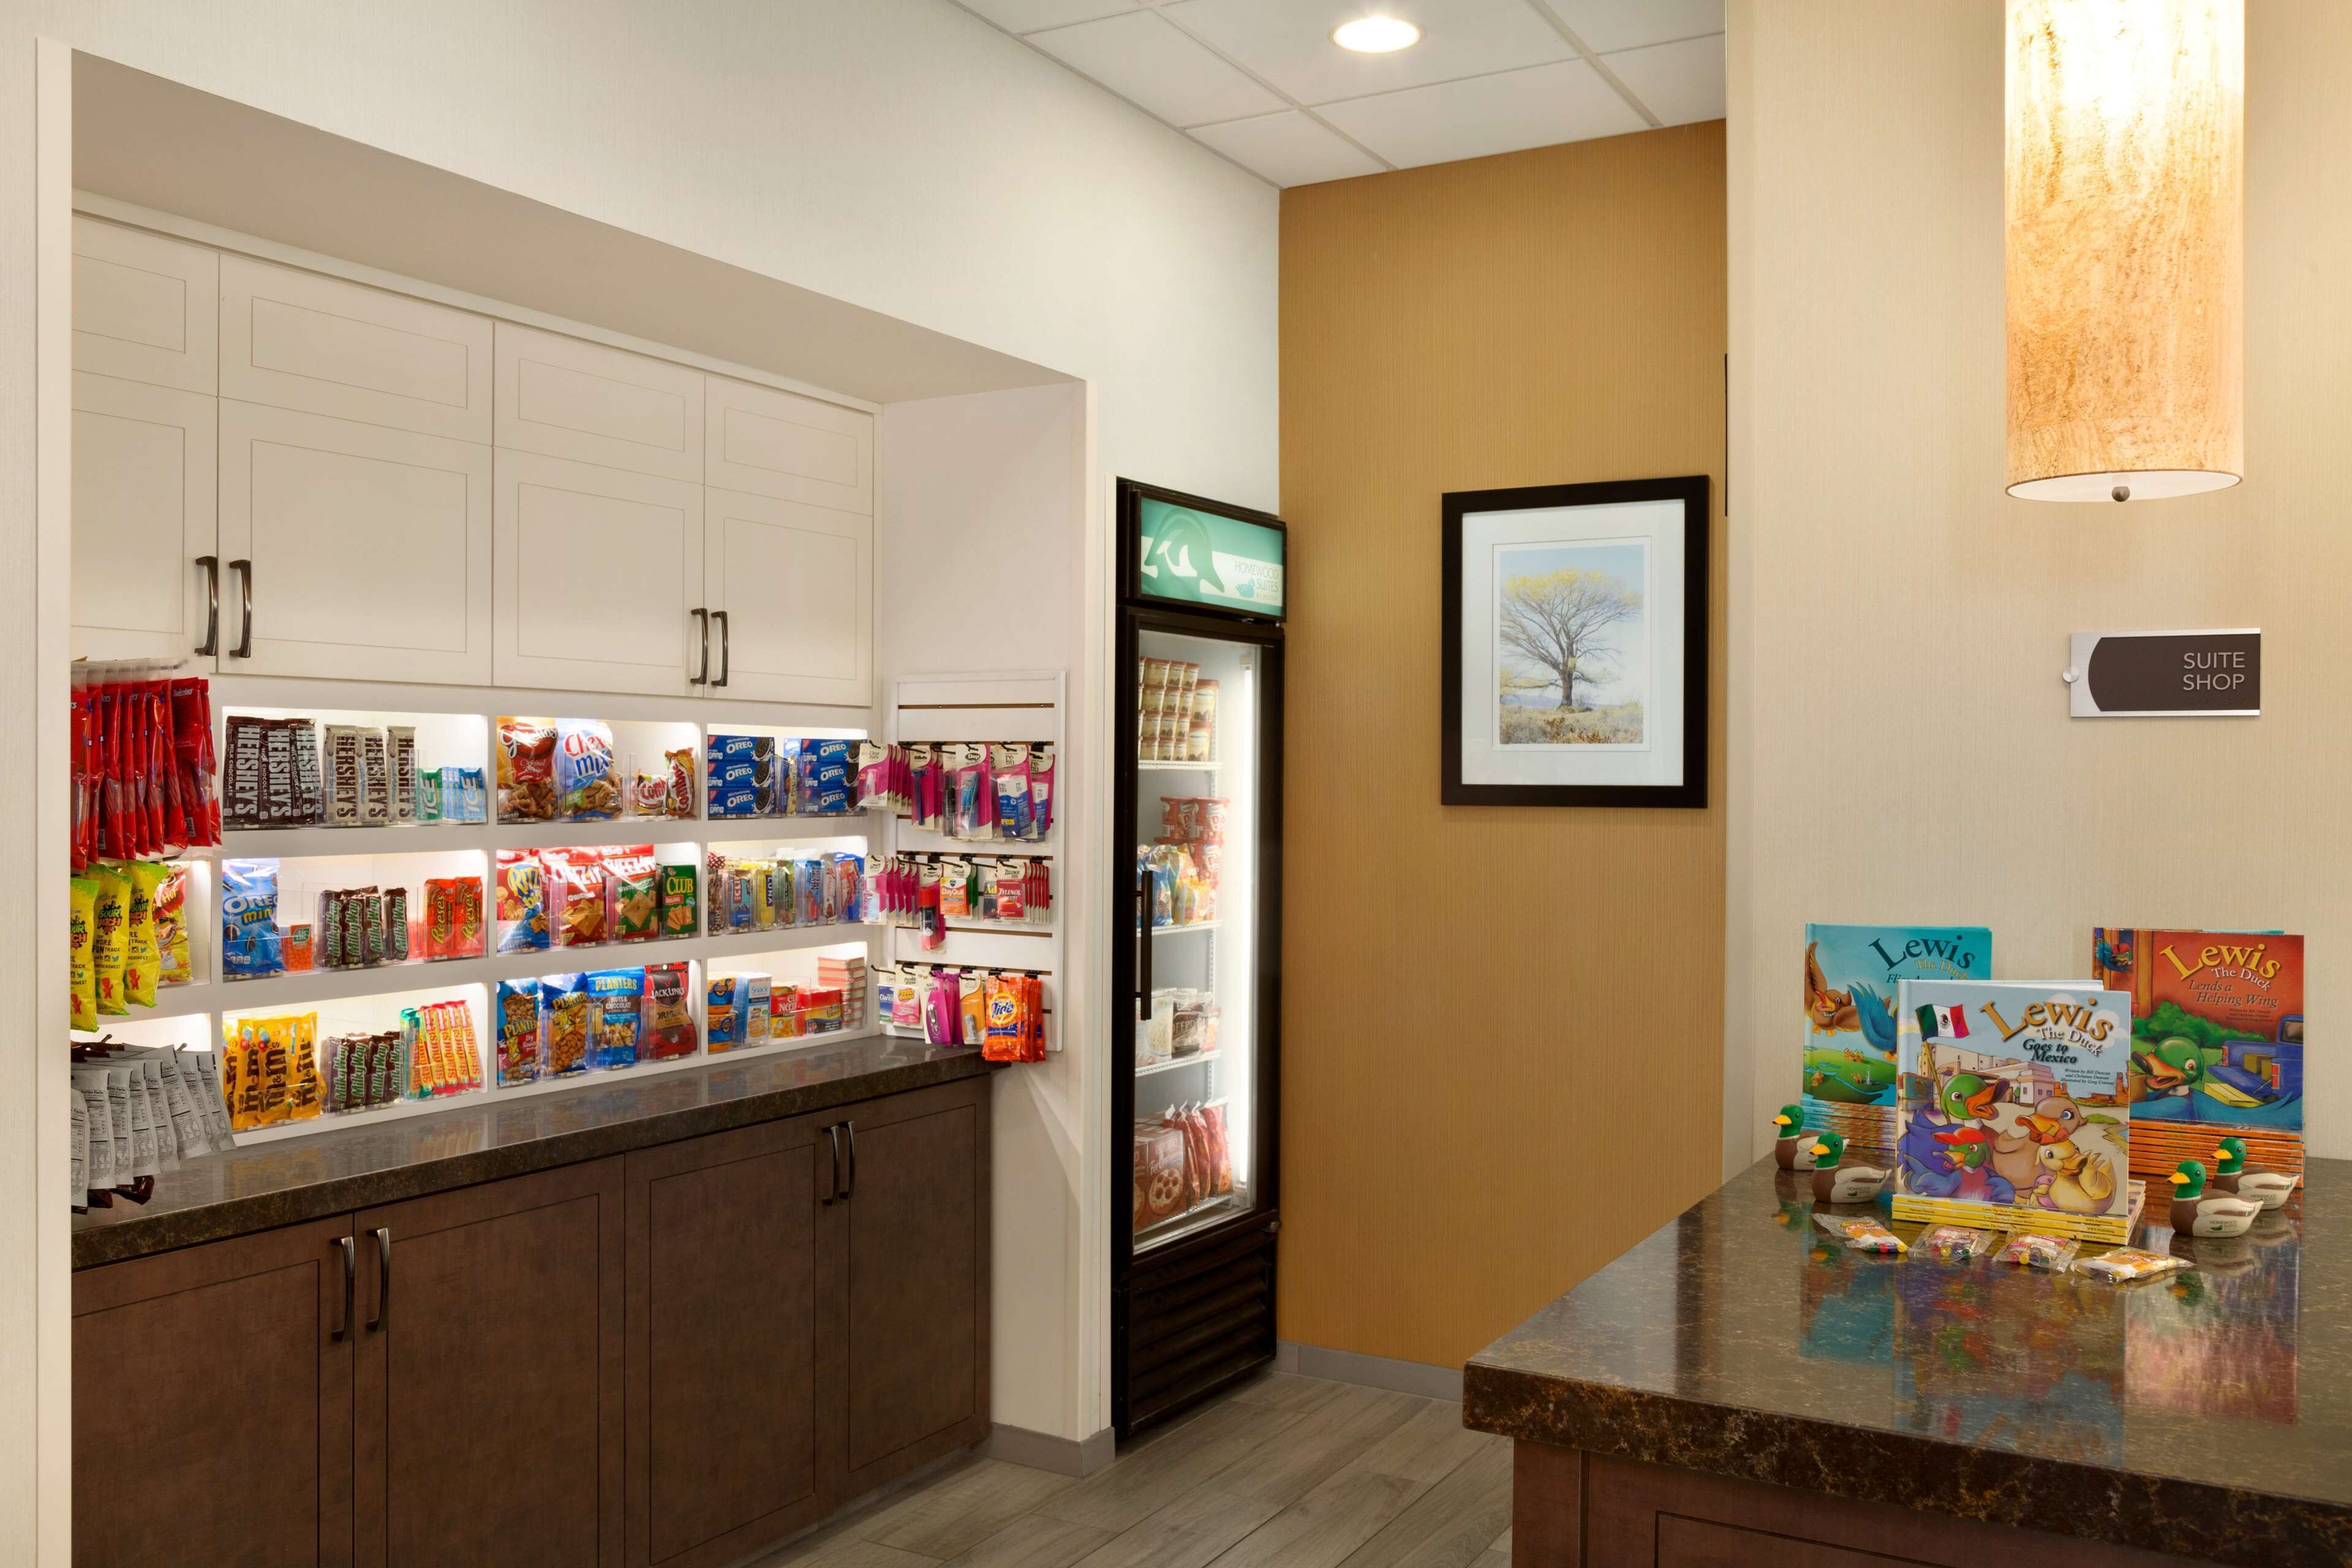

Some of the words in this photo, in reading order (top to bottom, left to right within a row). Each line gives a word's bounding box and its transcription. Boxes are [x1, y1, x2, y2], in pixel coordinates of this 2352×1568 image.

[1234, 560, 1279, 579] HOMEWOOD
[1256, 578, 1279, 592] SUITES
[2183, 651, 2245, 669] SUITE
[2182, 674, 2245, 691] SHOP
[563, 733, 606, 758] Chex
[726, 741, 753, 755] OREO
[820, 743, 846, 756] OREO
[235, 727, 260, 815] HERSHEY'S
[268, 731, 291, 817] HERSHEY'S
[336, 736, 357, 818] HERSHEY'S
[365, 737, 388, 818] HERSHEY'S
[725, 767, 753, 781] OREO
[820, 768, 844, 782] OREO
[461, 775, 480, 812] ICE
[726, 794, 754, 808] OREO
[820, 793, 845, 807] OREO
[666, 876, 694, 895] CLUB
[99, 908, 121, 918] SOUR
[242, 907, 274, 924] min
[431, 894, 447, 944] Reese's
[461, 891, 475, 941] Reese's
[1868, 935, 1975, 971] Lewis
[2159, 943, 2282, 981] Lewis
[1914, 958, 1936, 970] The
[1940, 960, 1968, 980] Duck
[595, 978, 638, 992] PLANTERS
[2188, 980, 2223, 991] Lends
[2211, 967, 2236, 978] The
[2239, 968, 2271, 991] Duck
[651, 990, 669, 1000] JACK
[2196, 992, 2242, 1006] Helping
[2245, 993, 2278, 1008] Wing
[991, 1001, 1015, 1018] Tide
[1980, 997, 2114, 1042] Lewis
[503, 1020, 538, 1039] PLANTER
[2022, 1038, 2052, 1052] Goes
[2056, 1042, 2069, 1055] to
[2037, 1027, 2065, 1040] The
[2068, 1029, 2103, 1057] Duck
[2030, 1050, 2078, 1064] Mexico
